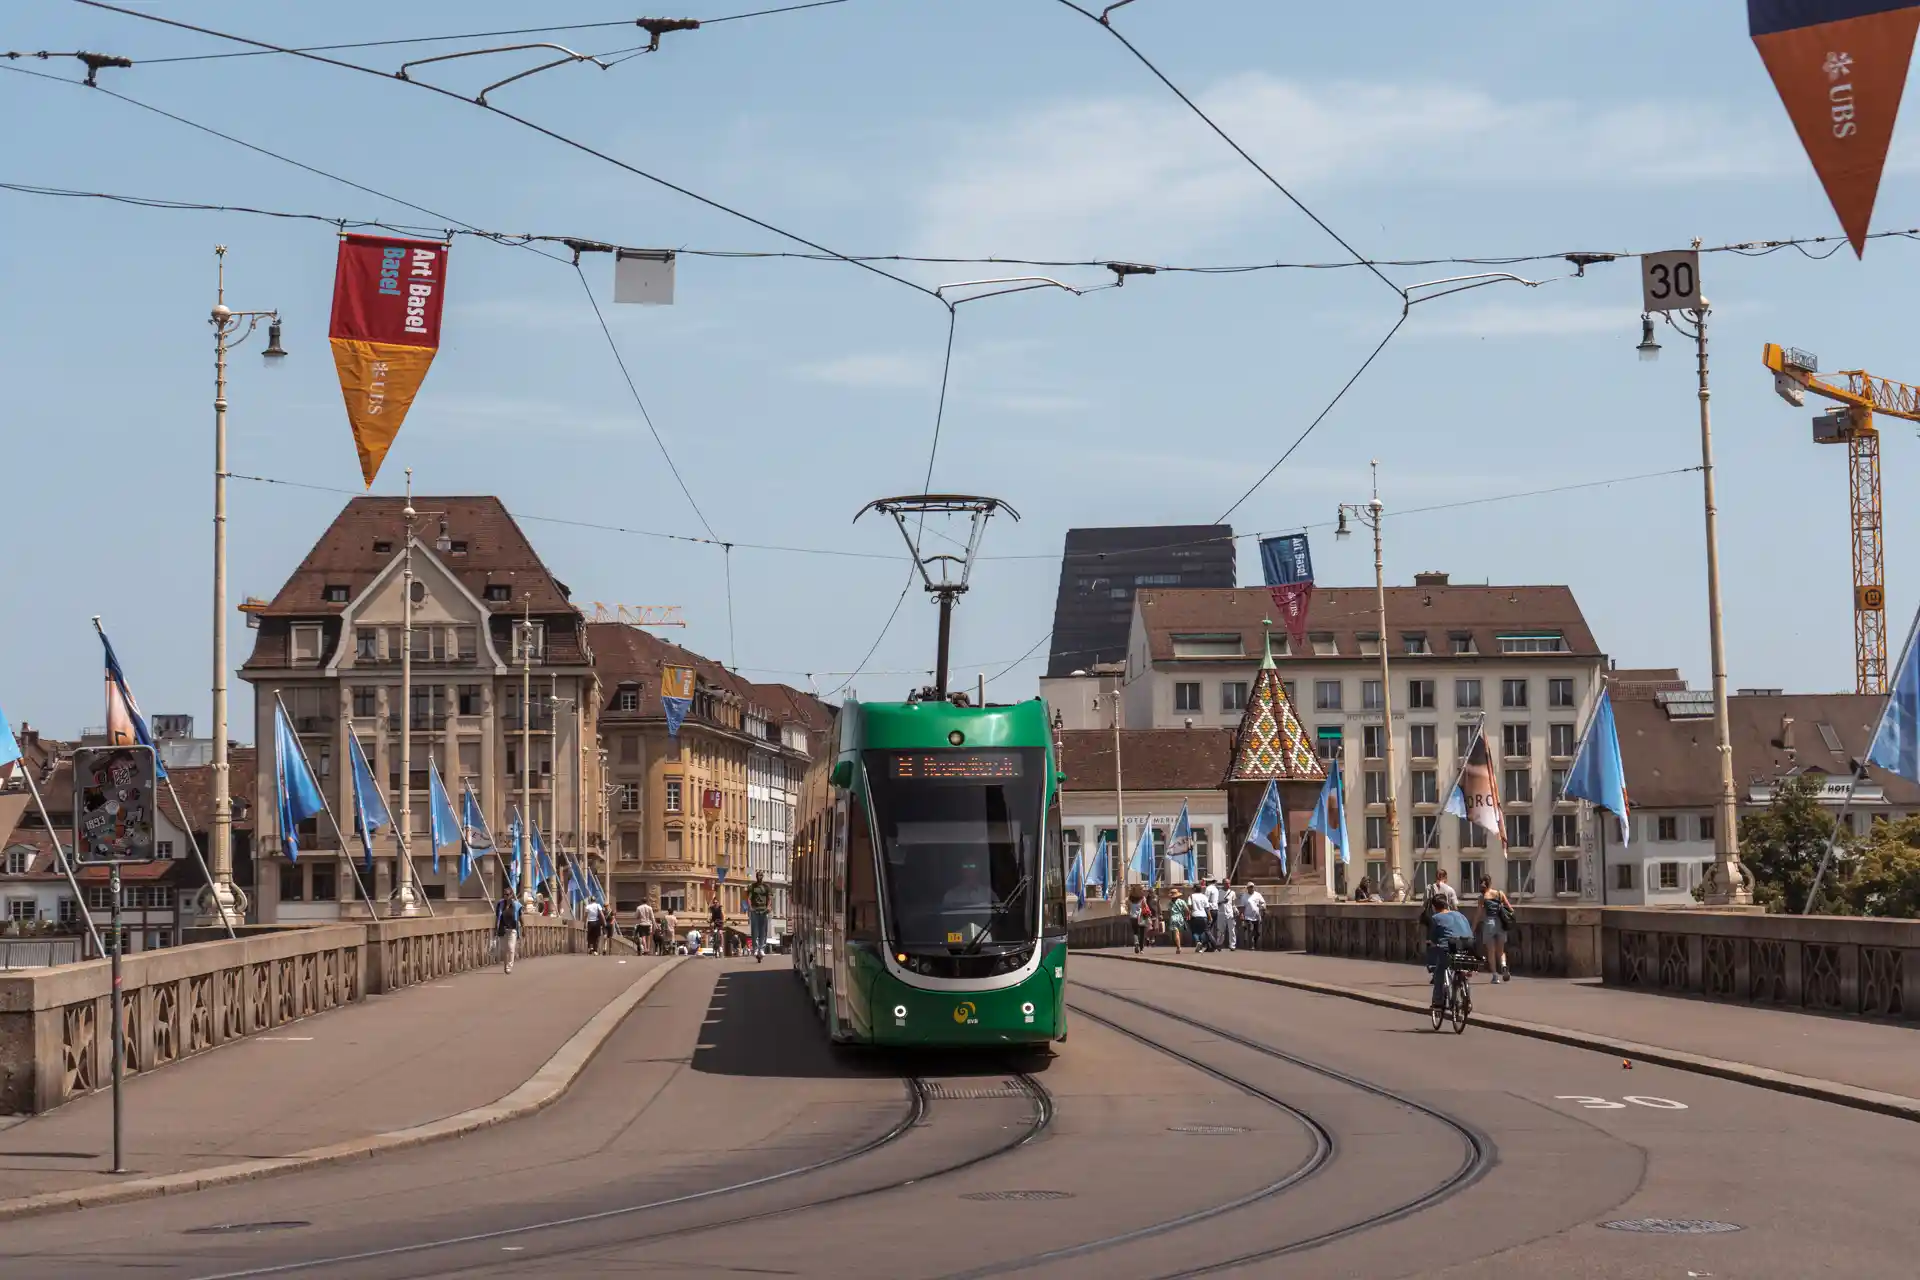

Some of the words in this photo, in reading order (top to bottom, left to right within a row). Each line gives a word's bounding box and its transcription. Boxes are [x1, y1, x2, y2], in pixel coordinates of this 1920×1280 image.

[1829, 83, 1857, 138] UBS
[378, 247, 406, 295] Basel
[411, 248, 436, 276] Art
[1650, 262, 1694, 299] 30
[404, 283, 432, 333] Basel
[367, 381, 385, 416] UBS
[84, 815, 106, 831] 1893
[1554, 1095, 1689, 1110] 30
